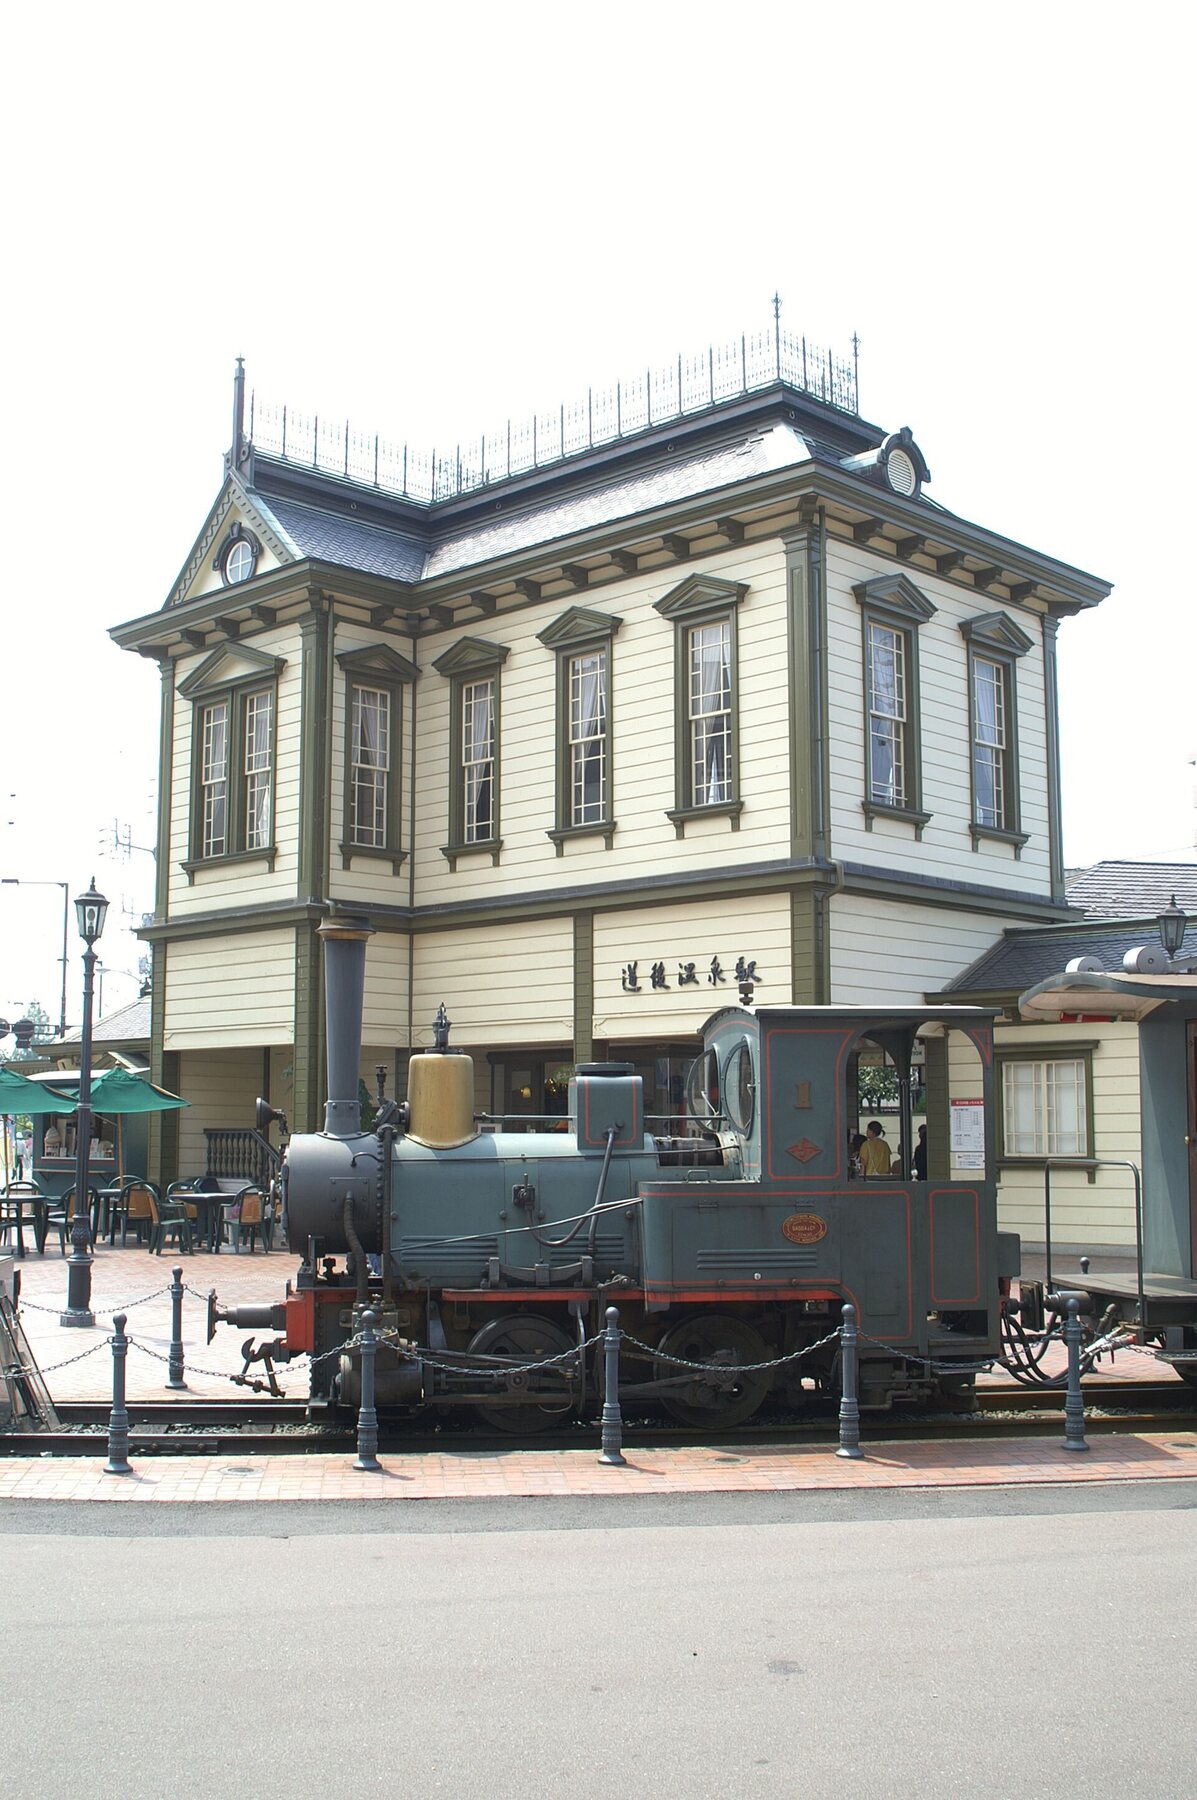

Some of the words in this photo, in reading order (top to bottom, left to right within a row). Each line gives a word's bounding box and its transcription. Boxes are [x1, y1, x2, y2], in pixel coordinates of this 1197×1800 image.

[621, 955, 762, 992] 道後温泉駅
[794, 1080, 813, 1109] 1
